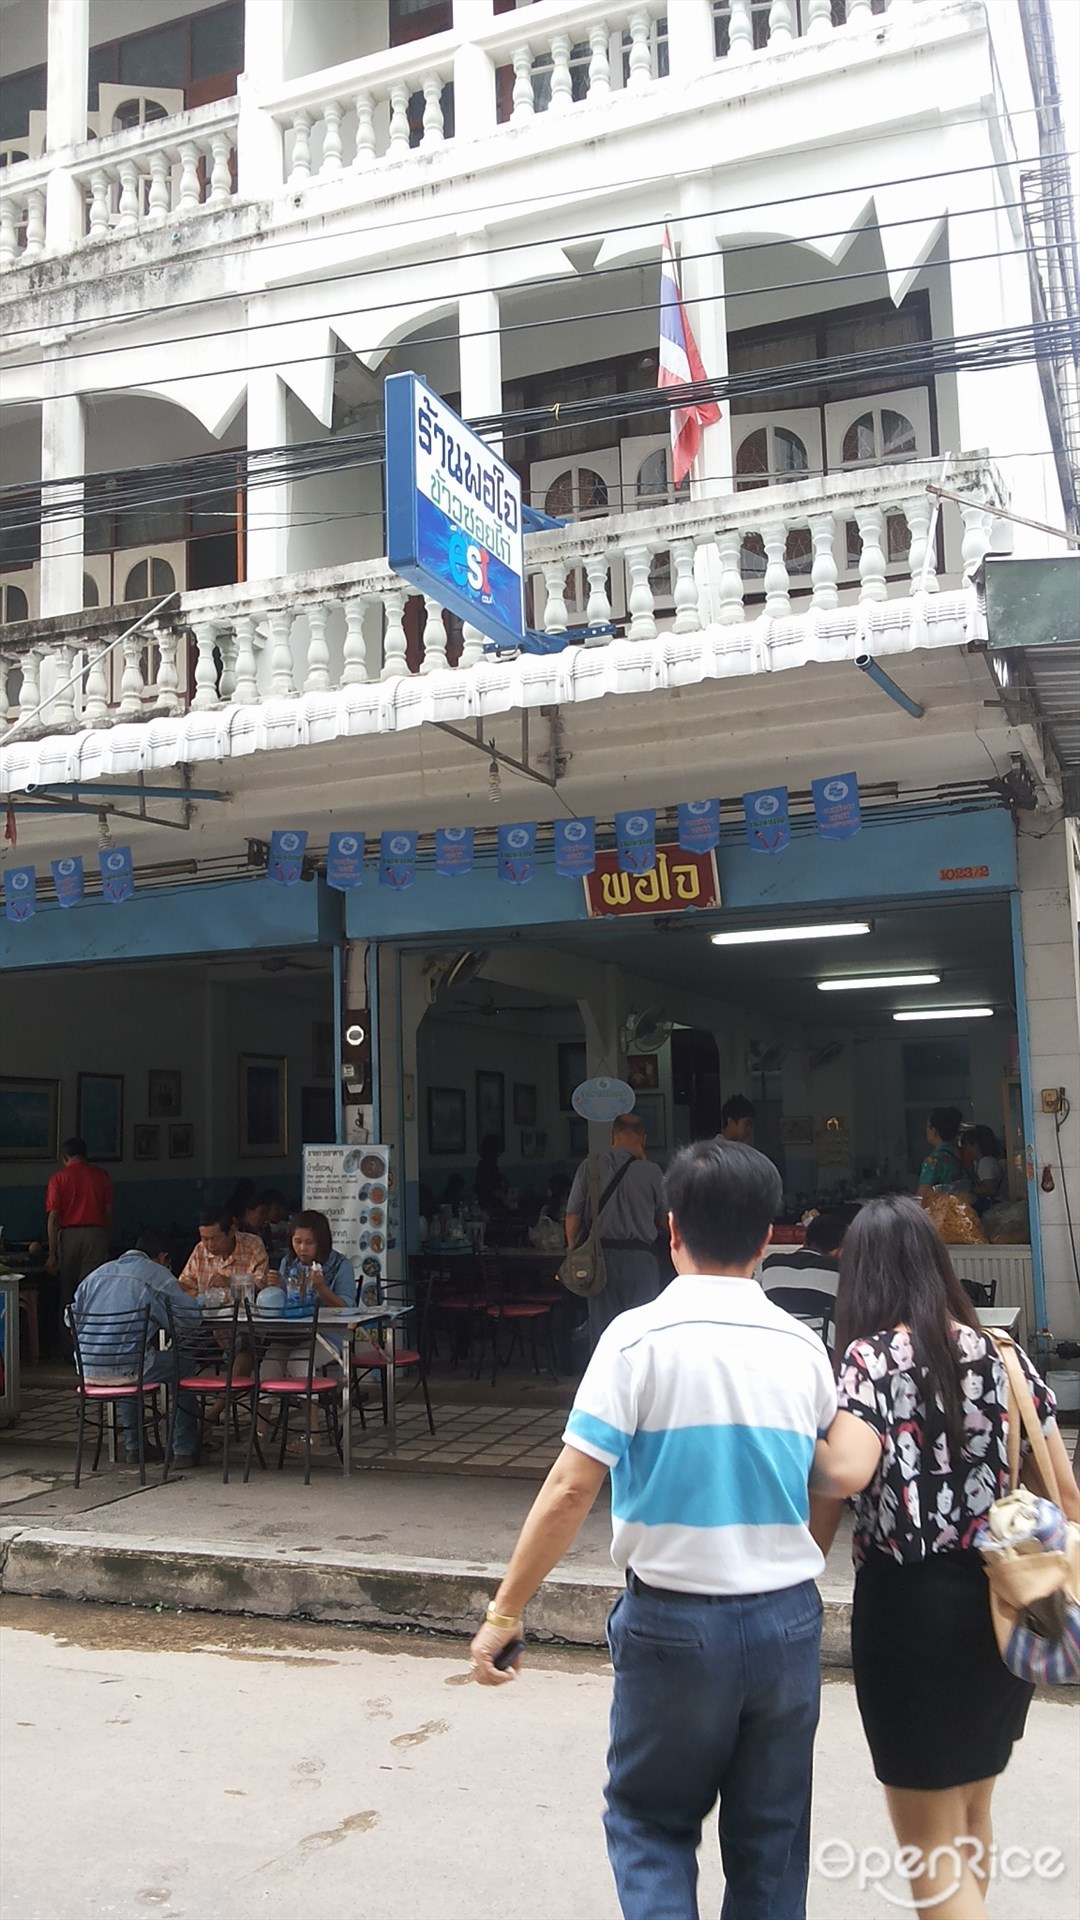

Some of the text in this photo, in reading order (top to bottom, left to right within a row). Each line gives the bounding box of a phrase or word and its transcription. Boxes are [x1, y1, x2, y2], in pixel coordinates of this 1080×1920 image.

[418, 396, 518, 534] ร้านพอใจ
[430, 468, 511, 566] ข้าวซอยไก่
[600, 852, 701, 906] พอใจ
